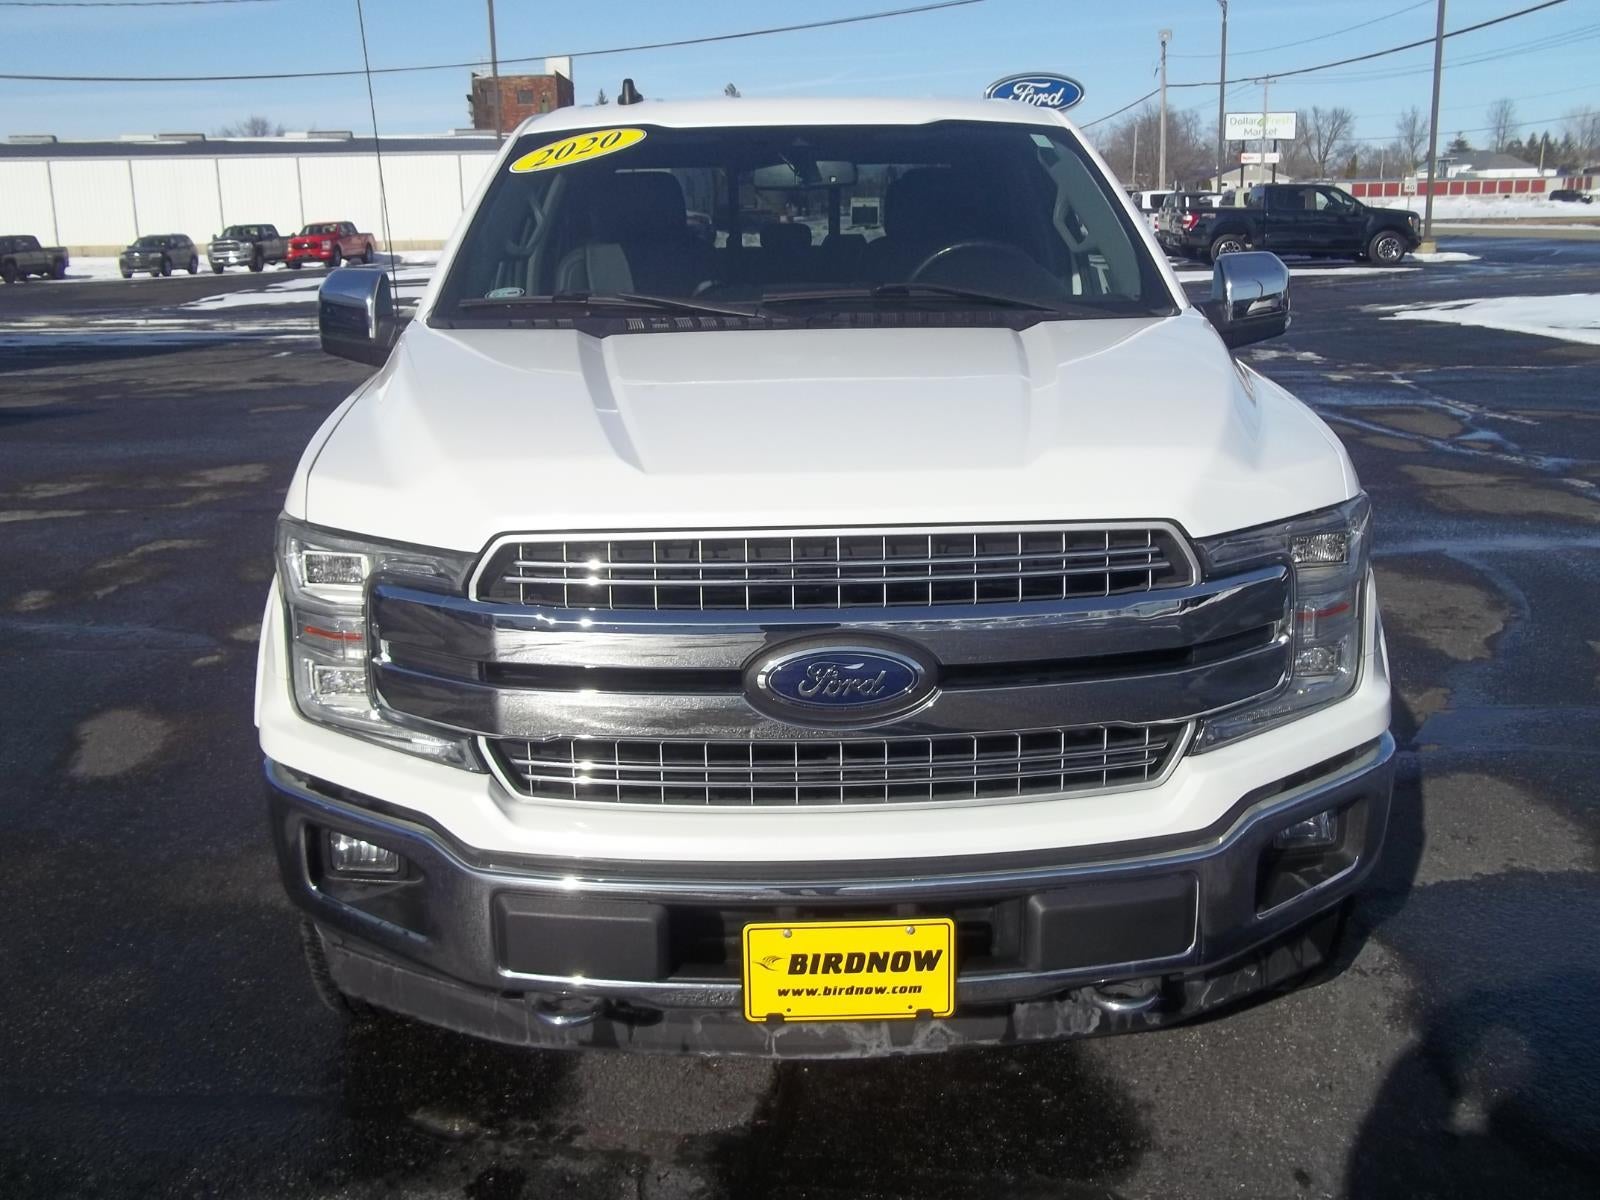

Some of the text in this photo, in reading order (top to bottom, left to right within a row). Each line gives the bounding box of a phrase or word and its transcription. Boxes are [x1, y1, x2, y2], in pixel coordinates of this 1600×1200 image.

[1009, 82, 1064, 106] Ford
[1229, 116, 1256, 126] Dollar
[532, 131, 622, 167] 2020
[798, 661, 886, 697] Ford
[788, 949, 943, 975] BIRDNOW
[777, 985, 922, 997] www.birdnow.com
